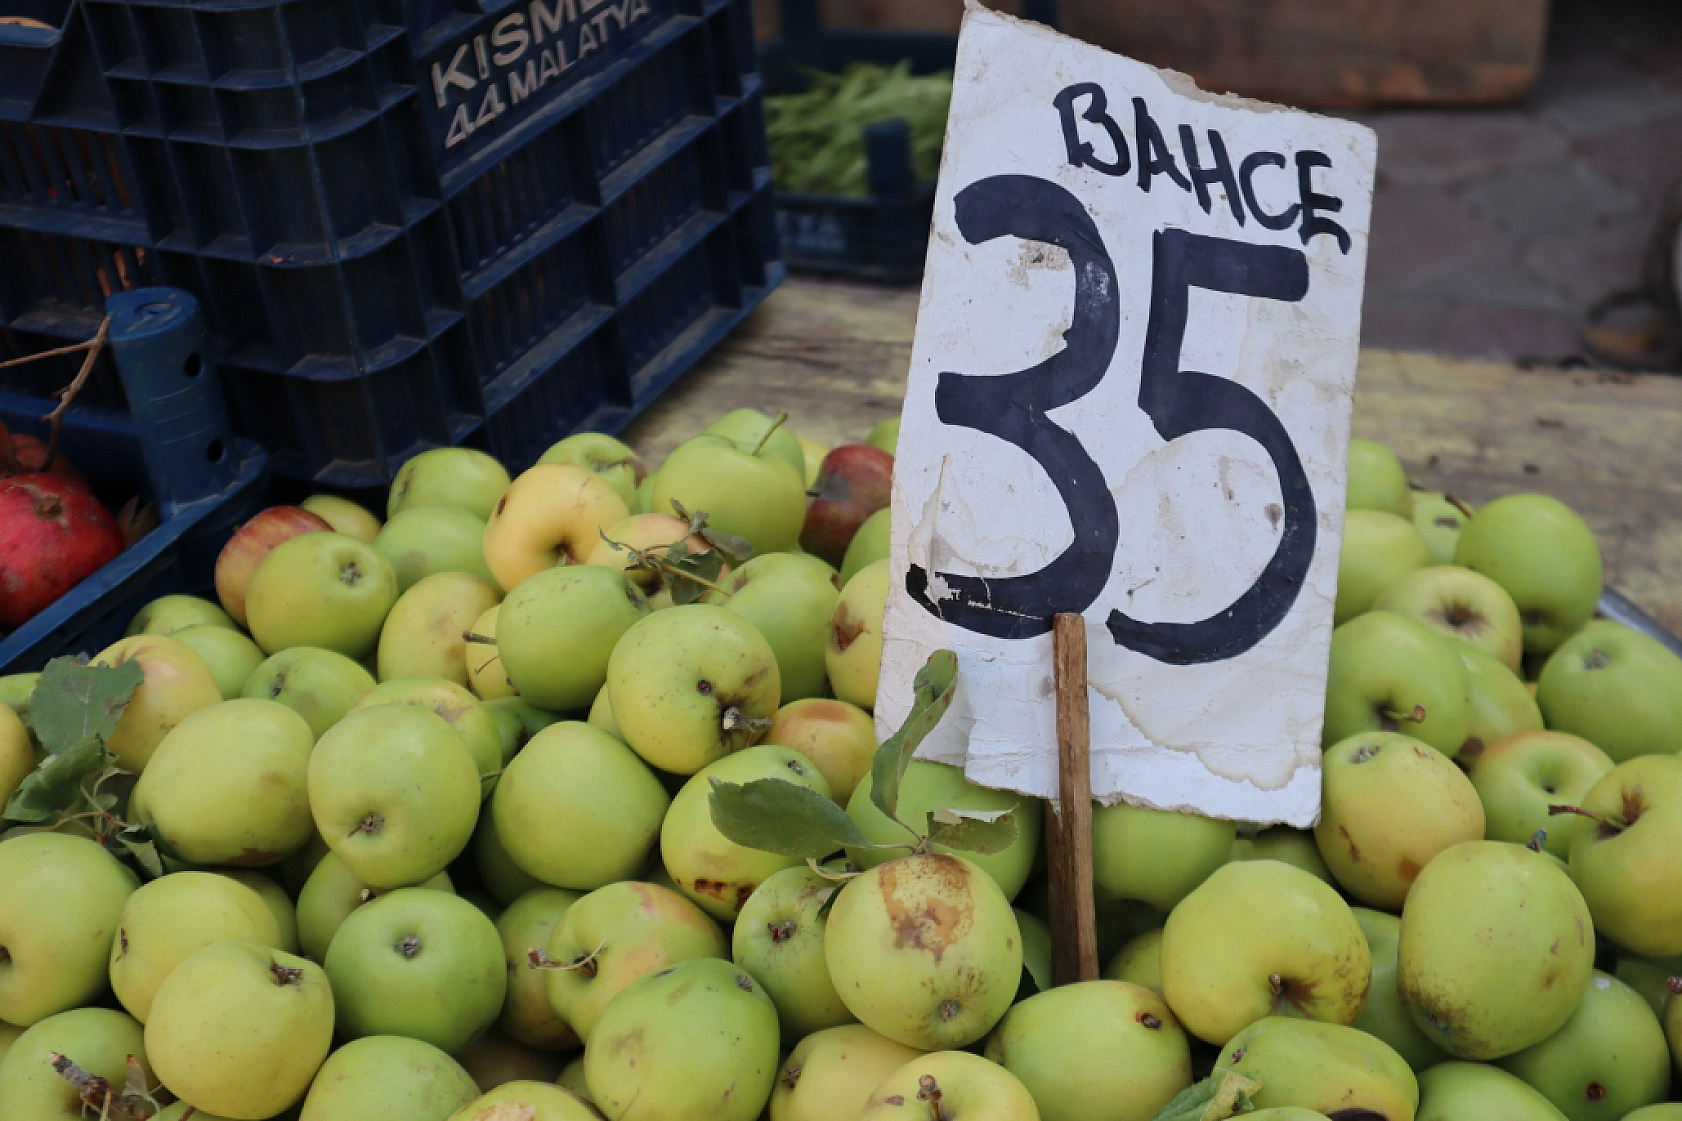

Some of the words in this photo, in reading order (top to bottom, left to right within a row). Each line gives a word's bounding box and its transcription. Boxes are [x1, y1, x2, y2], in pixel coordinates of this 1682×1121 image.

[444, 83, 506, 149] 44
[508, 0, 650, 105] MALATYA
[1053, 82, 1351, 255] BAHCE
[906, 174, 1317, 665] 35
